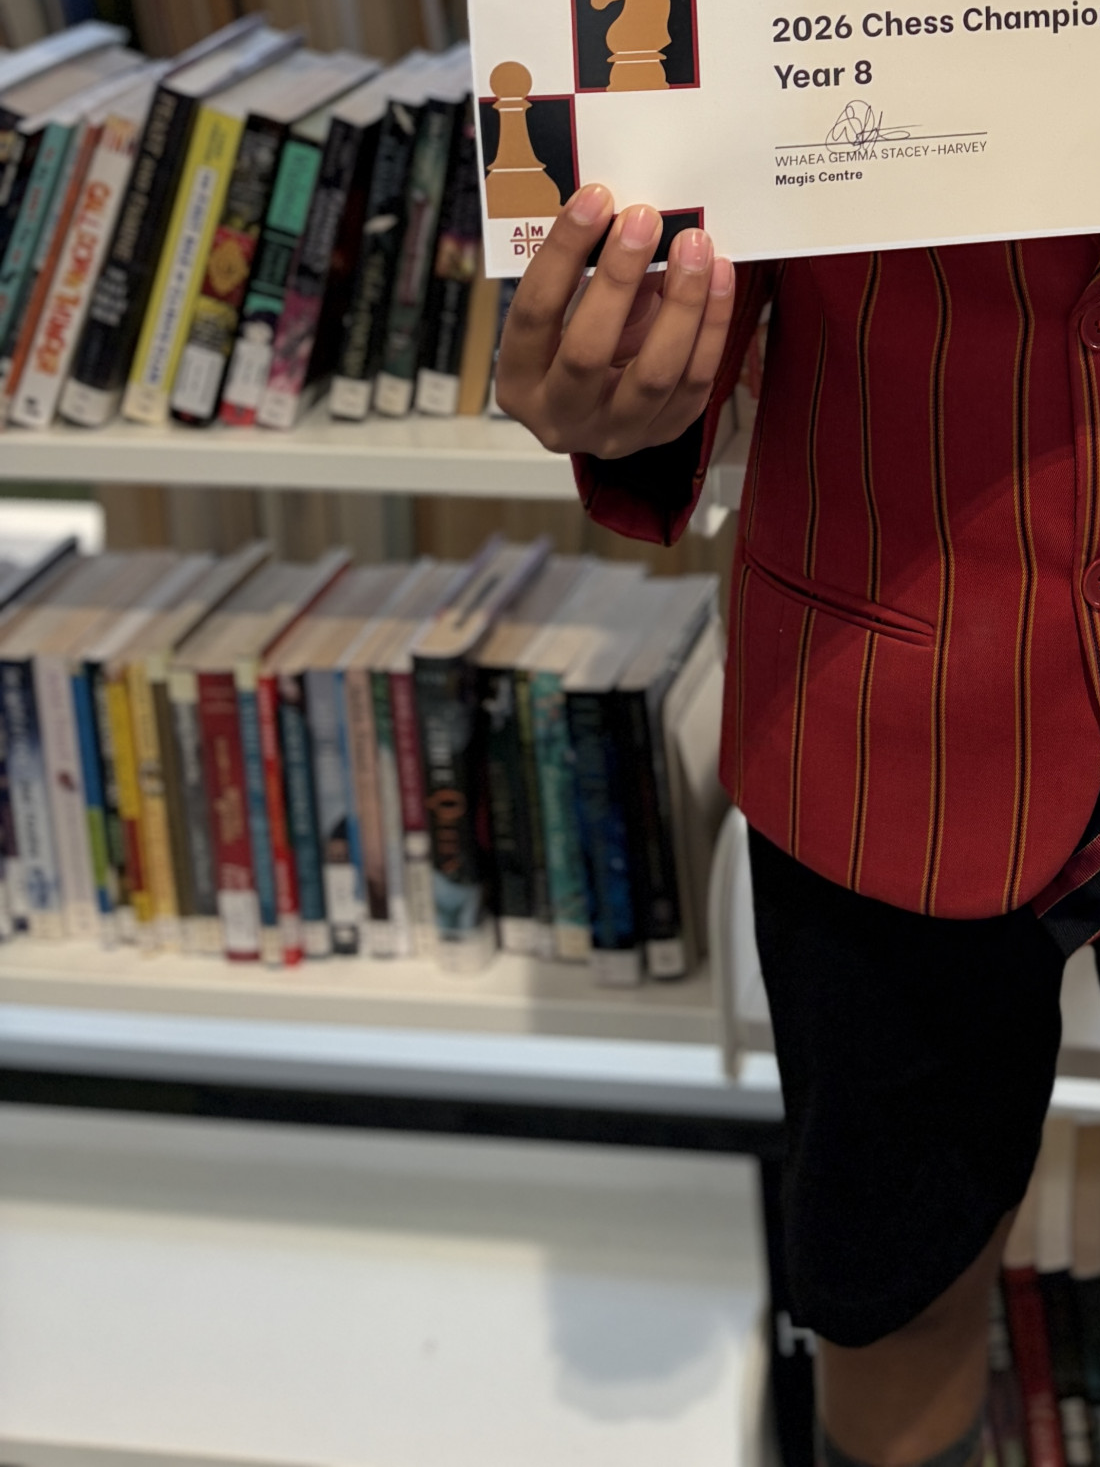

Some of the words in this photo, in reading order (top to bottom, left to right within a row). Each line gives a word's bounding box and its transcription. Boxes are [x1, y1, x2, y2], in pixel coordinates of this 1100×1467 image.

[772, 15, 853, 43] 2026
[862, 11, 954, 38] Chess
[774, 64, 846, 90] Year
[854, 60, 873, 85] 8
[775, 155, 826, 167] WHAEA
[828, 150, 878, 163] GEMMA
[881, 141, 988, 160] STACEY-HARVEY
[775, 171, 815, 187] Magis
[818, 169, 863, 182] Centre
